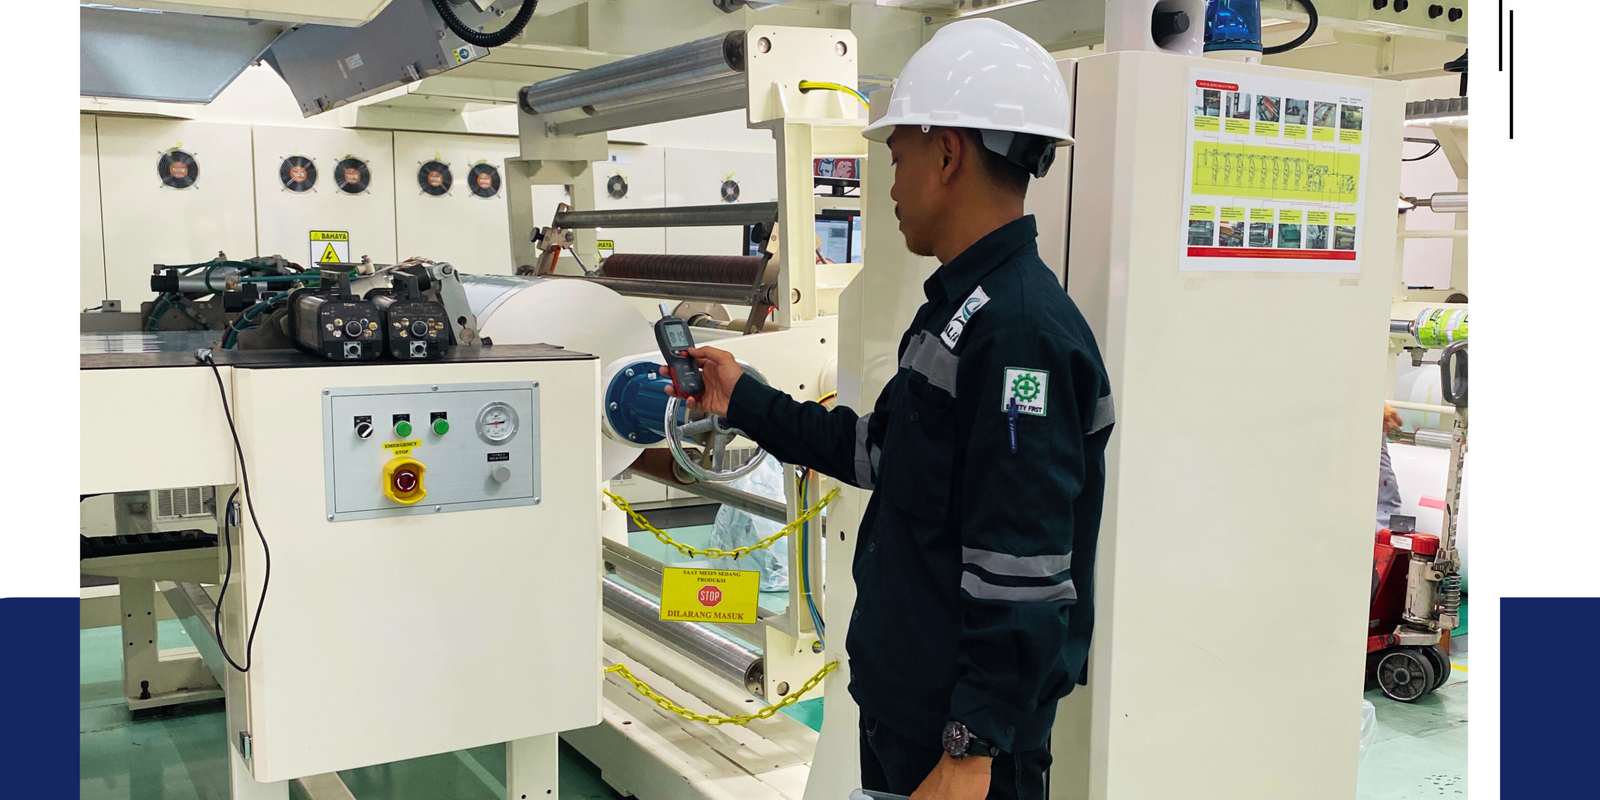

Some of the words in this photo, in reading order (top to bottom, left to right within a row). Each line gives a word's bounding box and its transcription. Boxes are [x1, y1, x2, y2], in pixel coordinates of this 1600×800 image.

[1005, 403, 1028, 411] SETY
[1028, 405, 1043, 413] FIRST
[384, 441, 418, 449] EMERGENCY
[700, 590, 720, 601] STOP
[667, 610, 712, 619] DILARANG
[713, 611, 744, 620] MASUK
